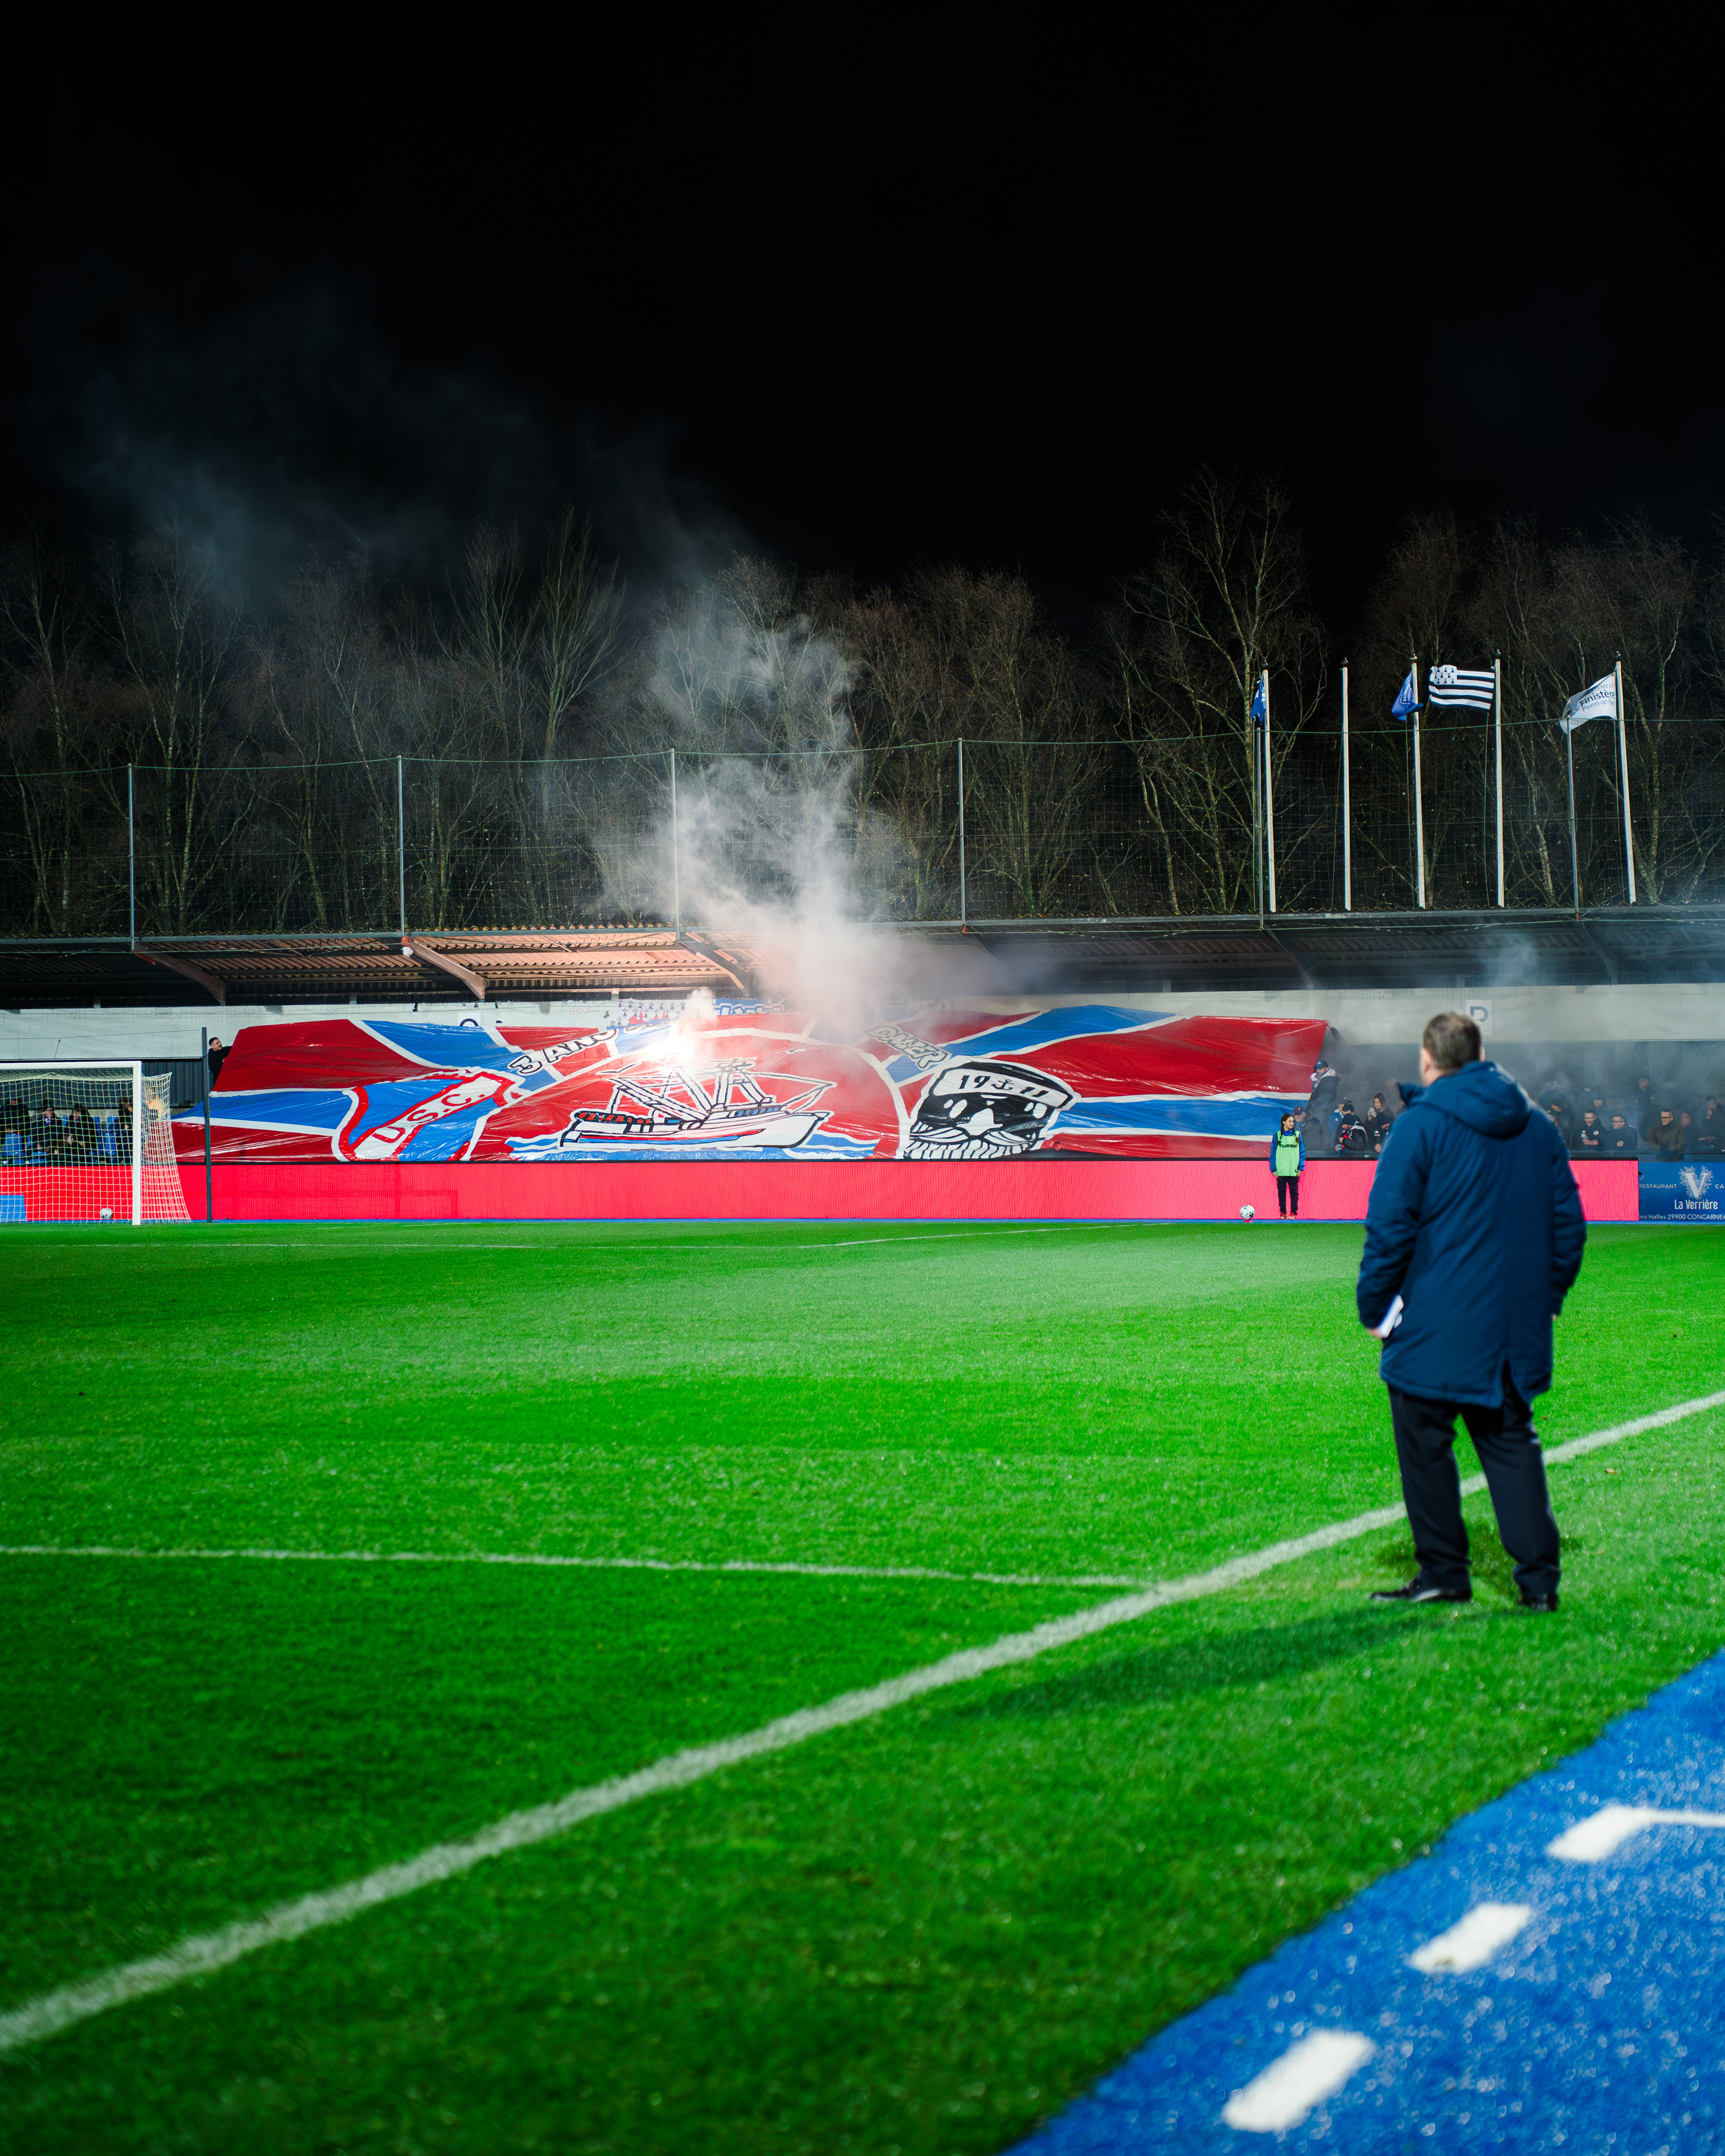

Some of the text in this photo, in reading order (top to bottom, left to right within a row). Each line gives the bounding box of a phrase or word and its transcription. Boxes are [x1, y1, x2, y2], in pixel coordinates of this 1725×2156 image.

[1579, 689, 1615, 707] Finistère
[1675, 1199, 1718, 1210] La Verrière
